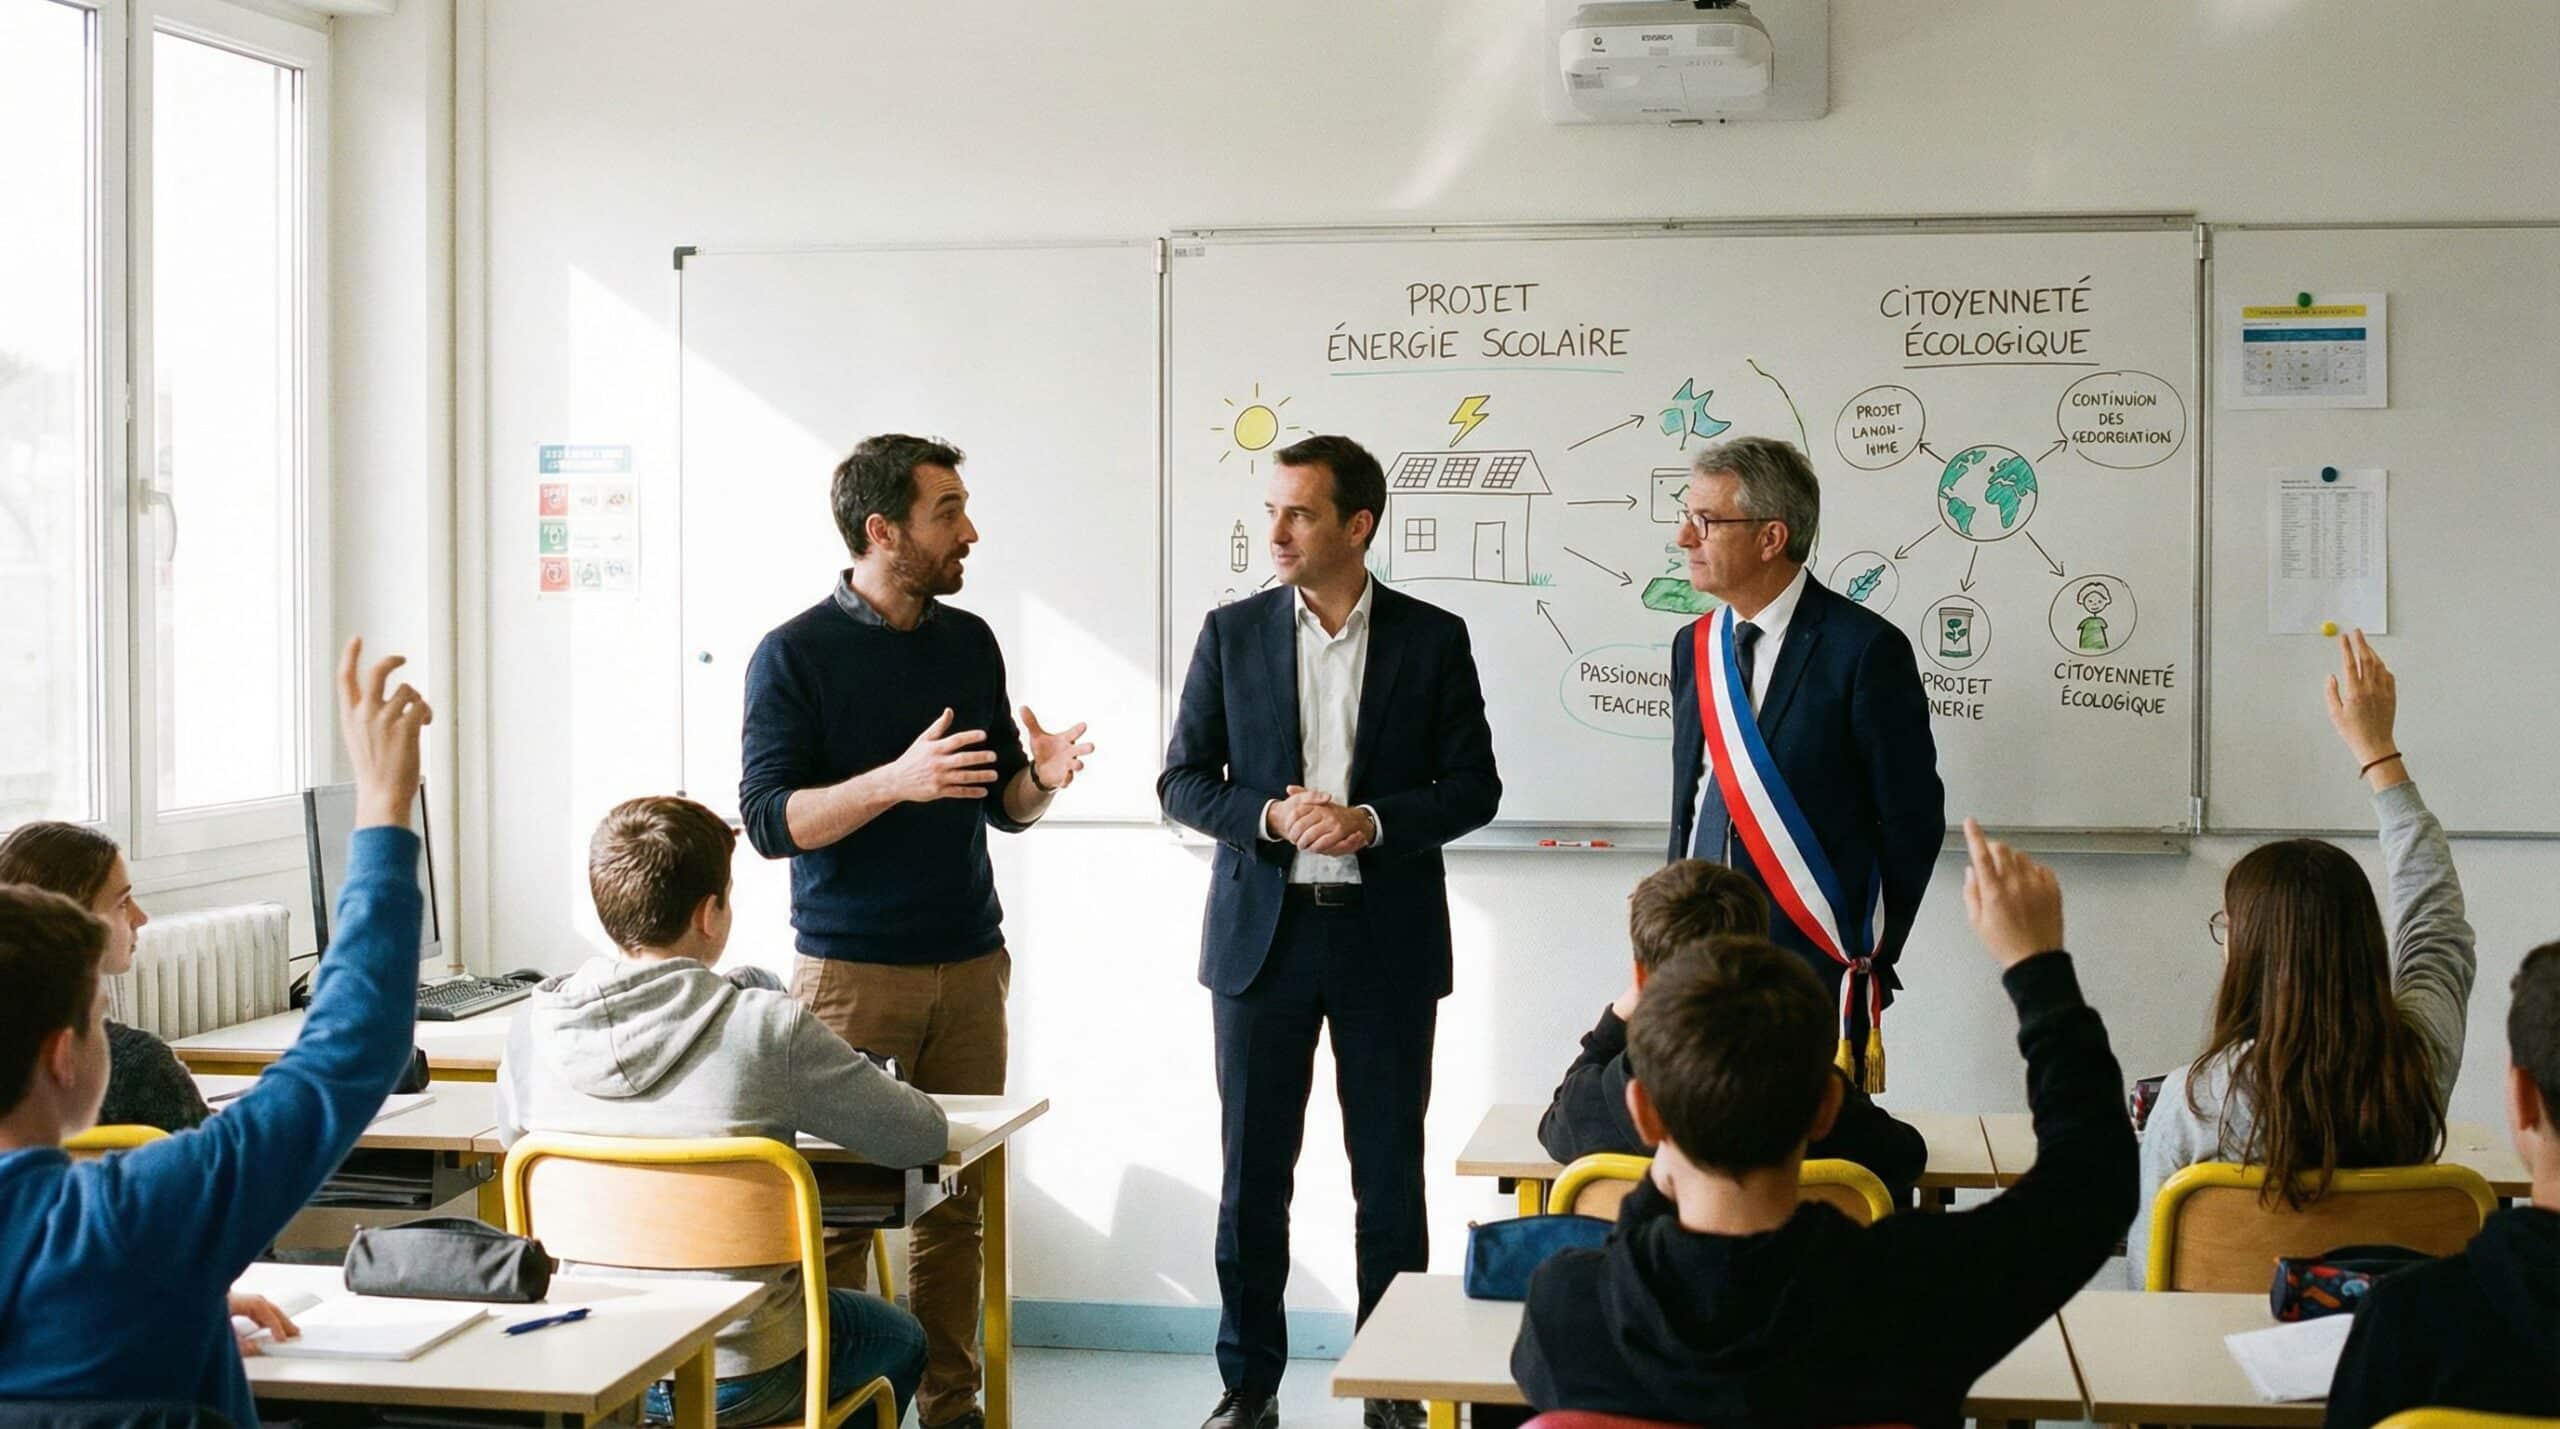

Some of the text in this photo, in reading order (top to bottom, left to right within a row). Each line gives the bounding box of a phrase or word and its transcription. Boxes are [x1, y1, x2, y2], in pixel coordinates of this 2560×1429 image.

[1406, 283, 1539, 316] PROJET
[1880, 275, 2091, 319] CITOYENNETÉ
[1327, 322, 1630, 361] ÉNERGIE SCOLAIRE
[1904, 322, 2091, 357] ÉCOLOGIQUE
[1856, 403, 1902, 419] PROJET
[2098, 412, 2124, 425] DES
[1922, 672, 1992, 694] PROJET
[2054, 661, 2175, 688] CITOYENNETÉ
[1589, 695, 1671, 719] TEACHER
[1929, 698, 1984, 720] NERIE
[2061, 686, 2166, 715] ÉCOLOGIQUE
